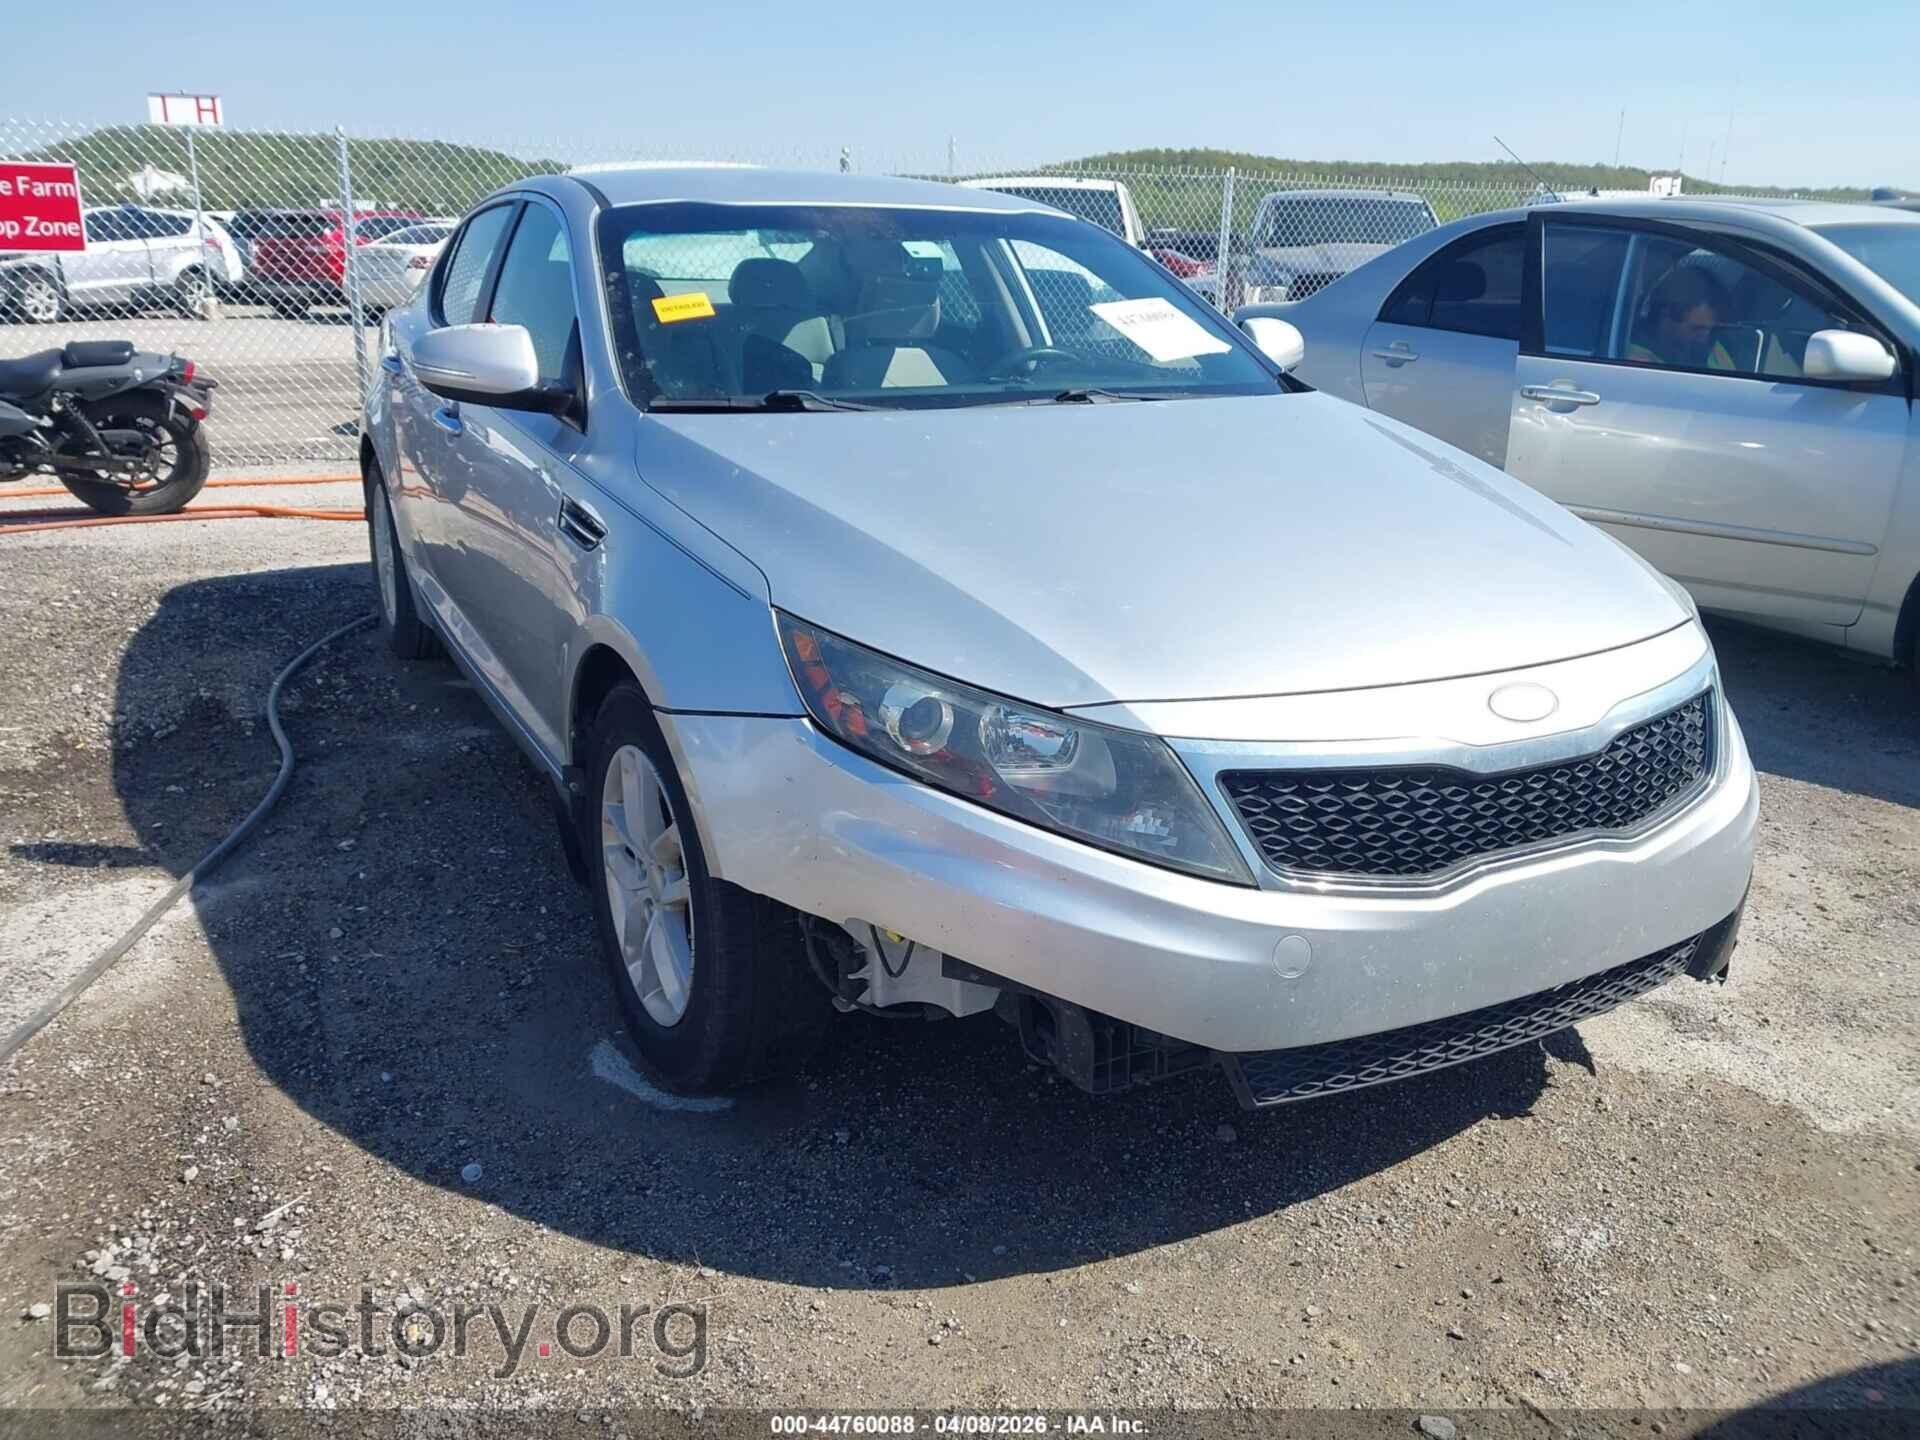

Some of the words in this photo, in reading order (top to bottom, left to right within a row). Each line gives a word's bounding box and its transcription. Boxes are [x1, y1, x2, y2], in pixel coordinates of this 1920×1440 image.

[194, 96, 218, 124] H
[16, 175, 76, 198] Farm
[23, 215, 81, 236] Zone
